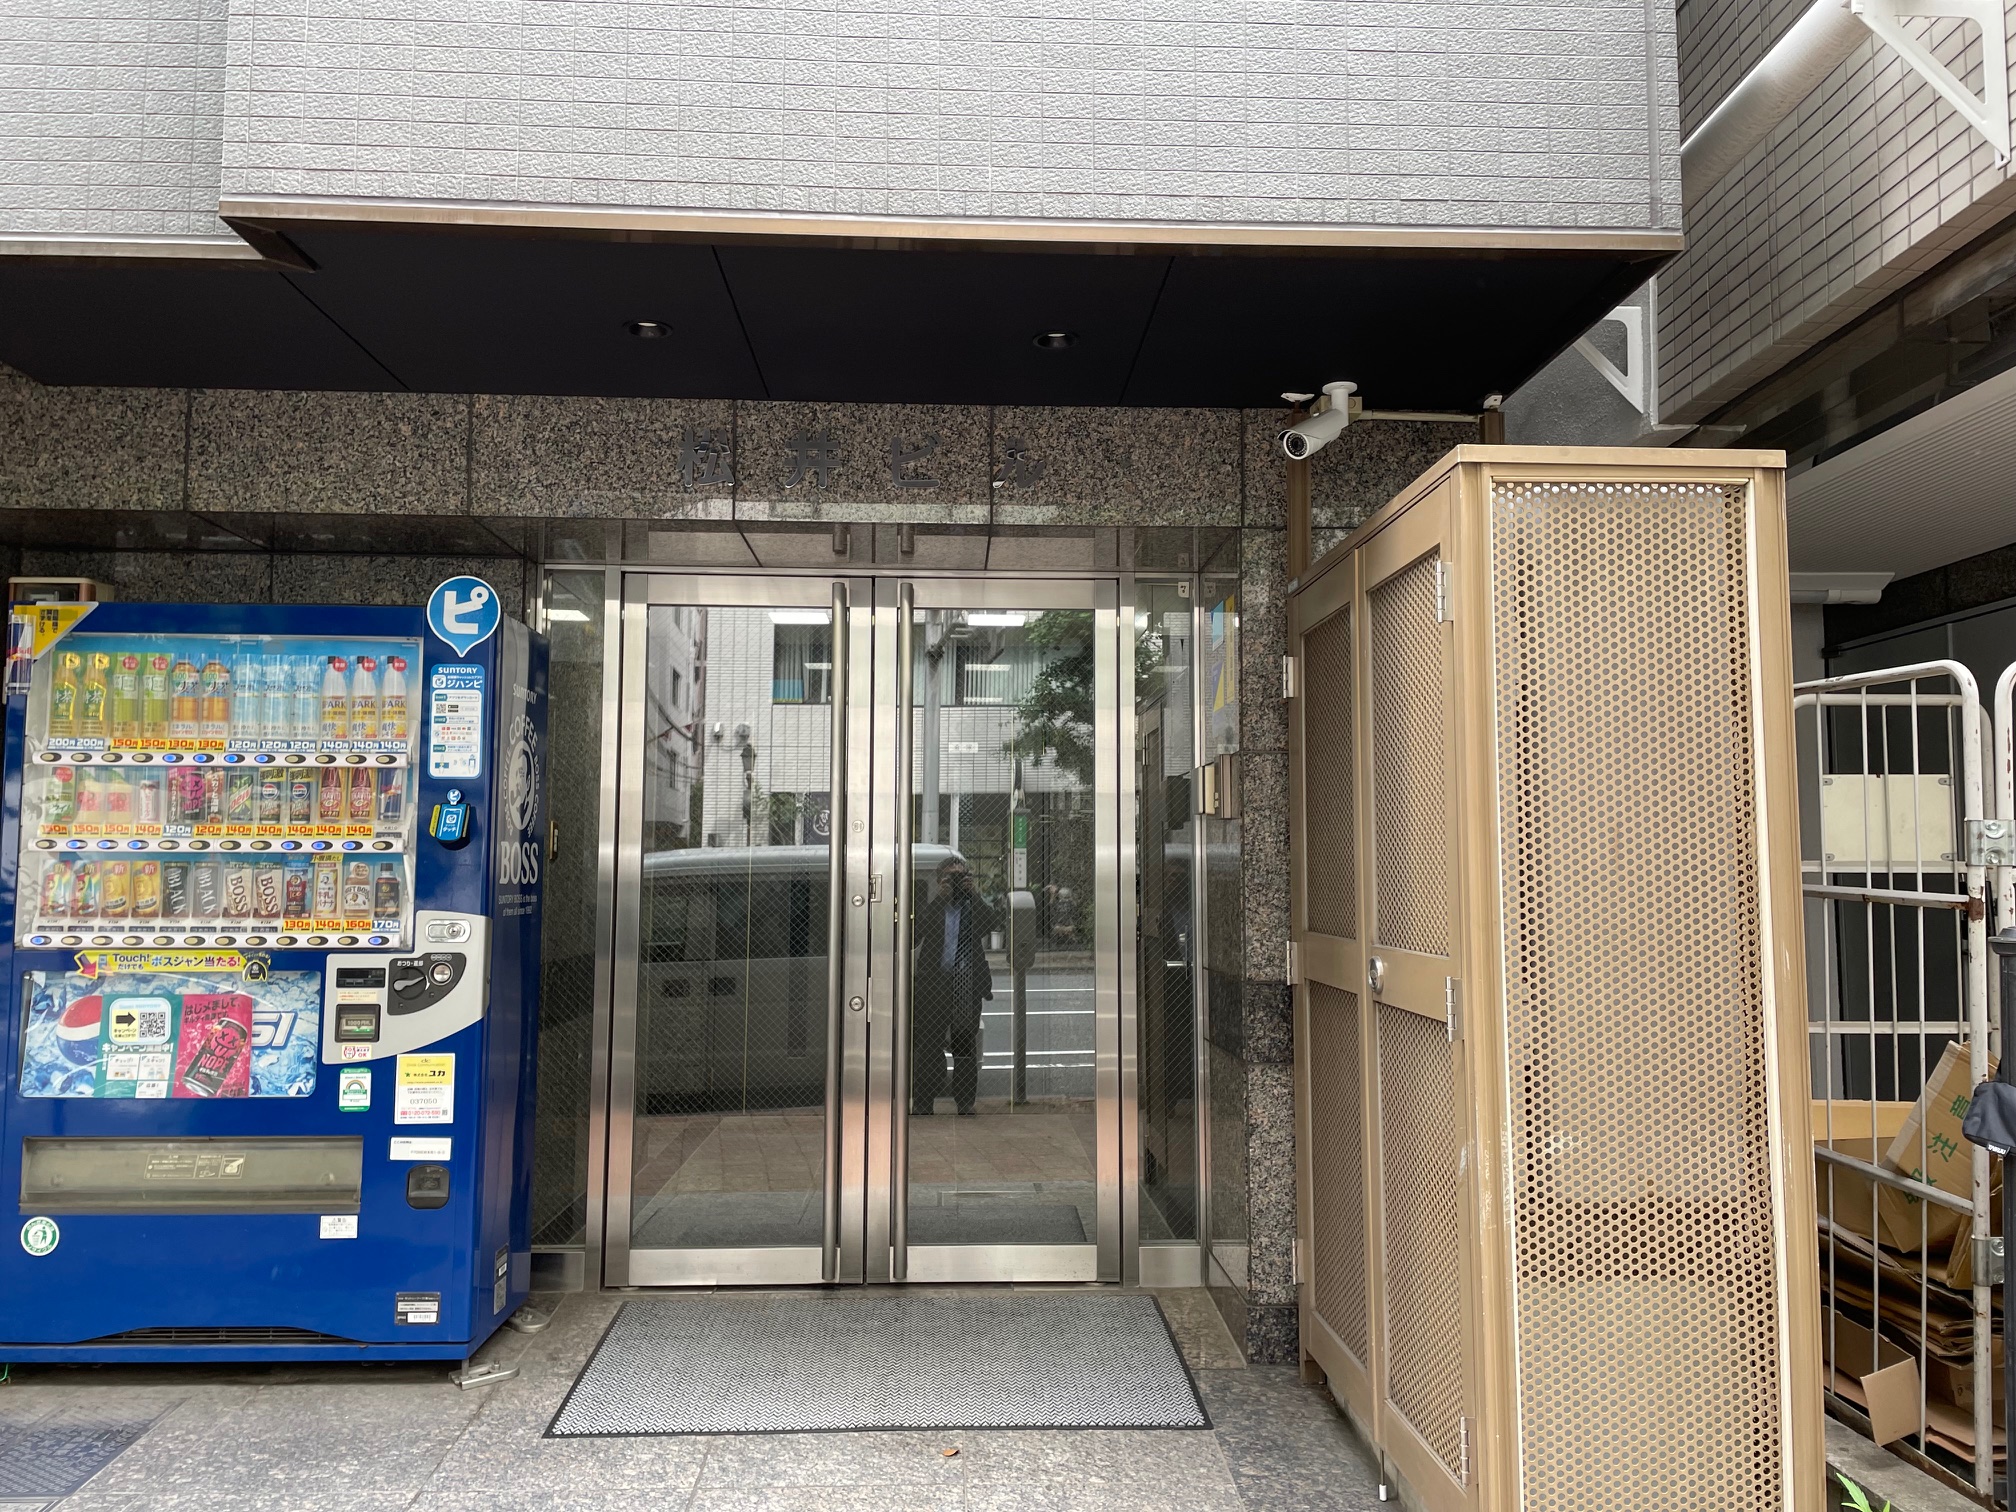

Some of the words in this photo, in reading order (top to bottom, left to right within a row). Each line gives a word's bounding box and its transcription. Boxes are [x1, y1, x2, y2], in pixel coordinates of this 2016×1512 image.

[677, 427, 1046, 489] 松井ビル
[442, 586, 489, 634] ピ
[447, 680, 482, 688] ジハンピ
[510, 714, 538, 753] COFFEE
[499, 842, 538, 884] BOSS
[168, 873, 186, 914] BLACK
[198, 873, 217, 914] BLACK
[230, 876, 248, 912] BOSS
[260, 876, 278, 912] BOSS
[113, 954, 150, 962] Touch!
[152, 956, 240, 967] ボスジャン当たる!
[198, 1054, 230, 1072] NOPE
